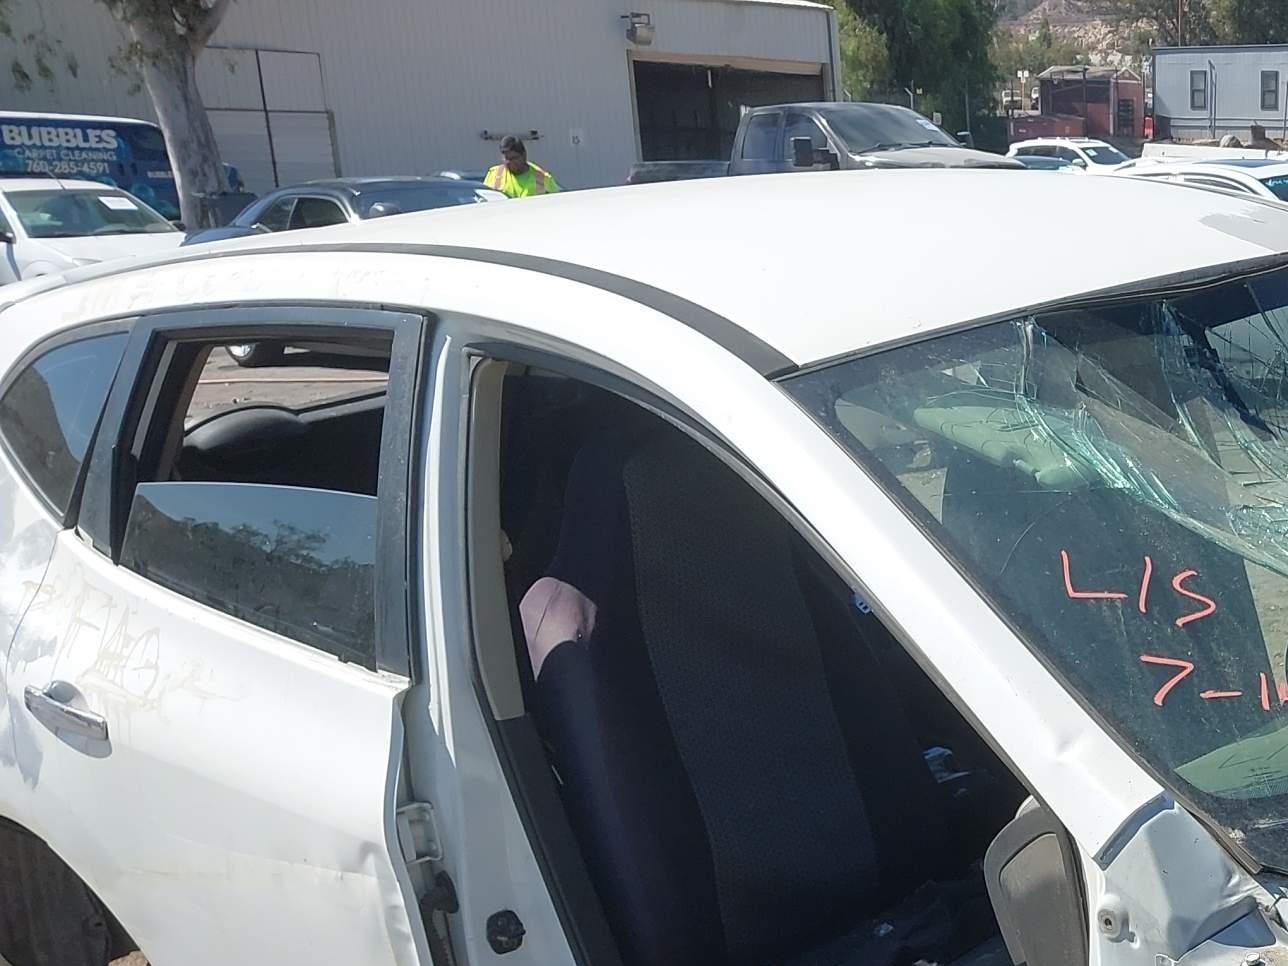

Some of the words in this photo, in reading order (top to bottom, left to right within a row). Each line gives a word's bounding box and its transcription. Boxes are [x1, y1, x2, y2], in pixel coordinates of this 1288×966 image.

[1, 125, 118, 149] BUBBLES
[15, 148, 59, 160] CARPET
[62, 150, 117, 161] CLEANING
[26, 159, 110, 174] 760-285-4591
